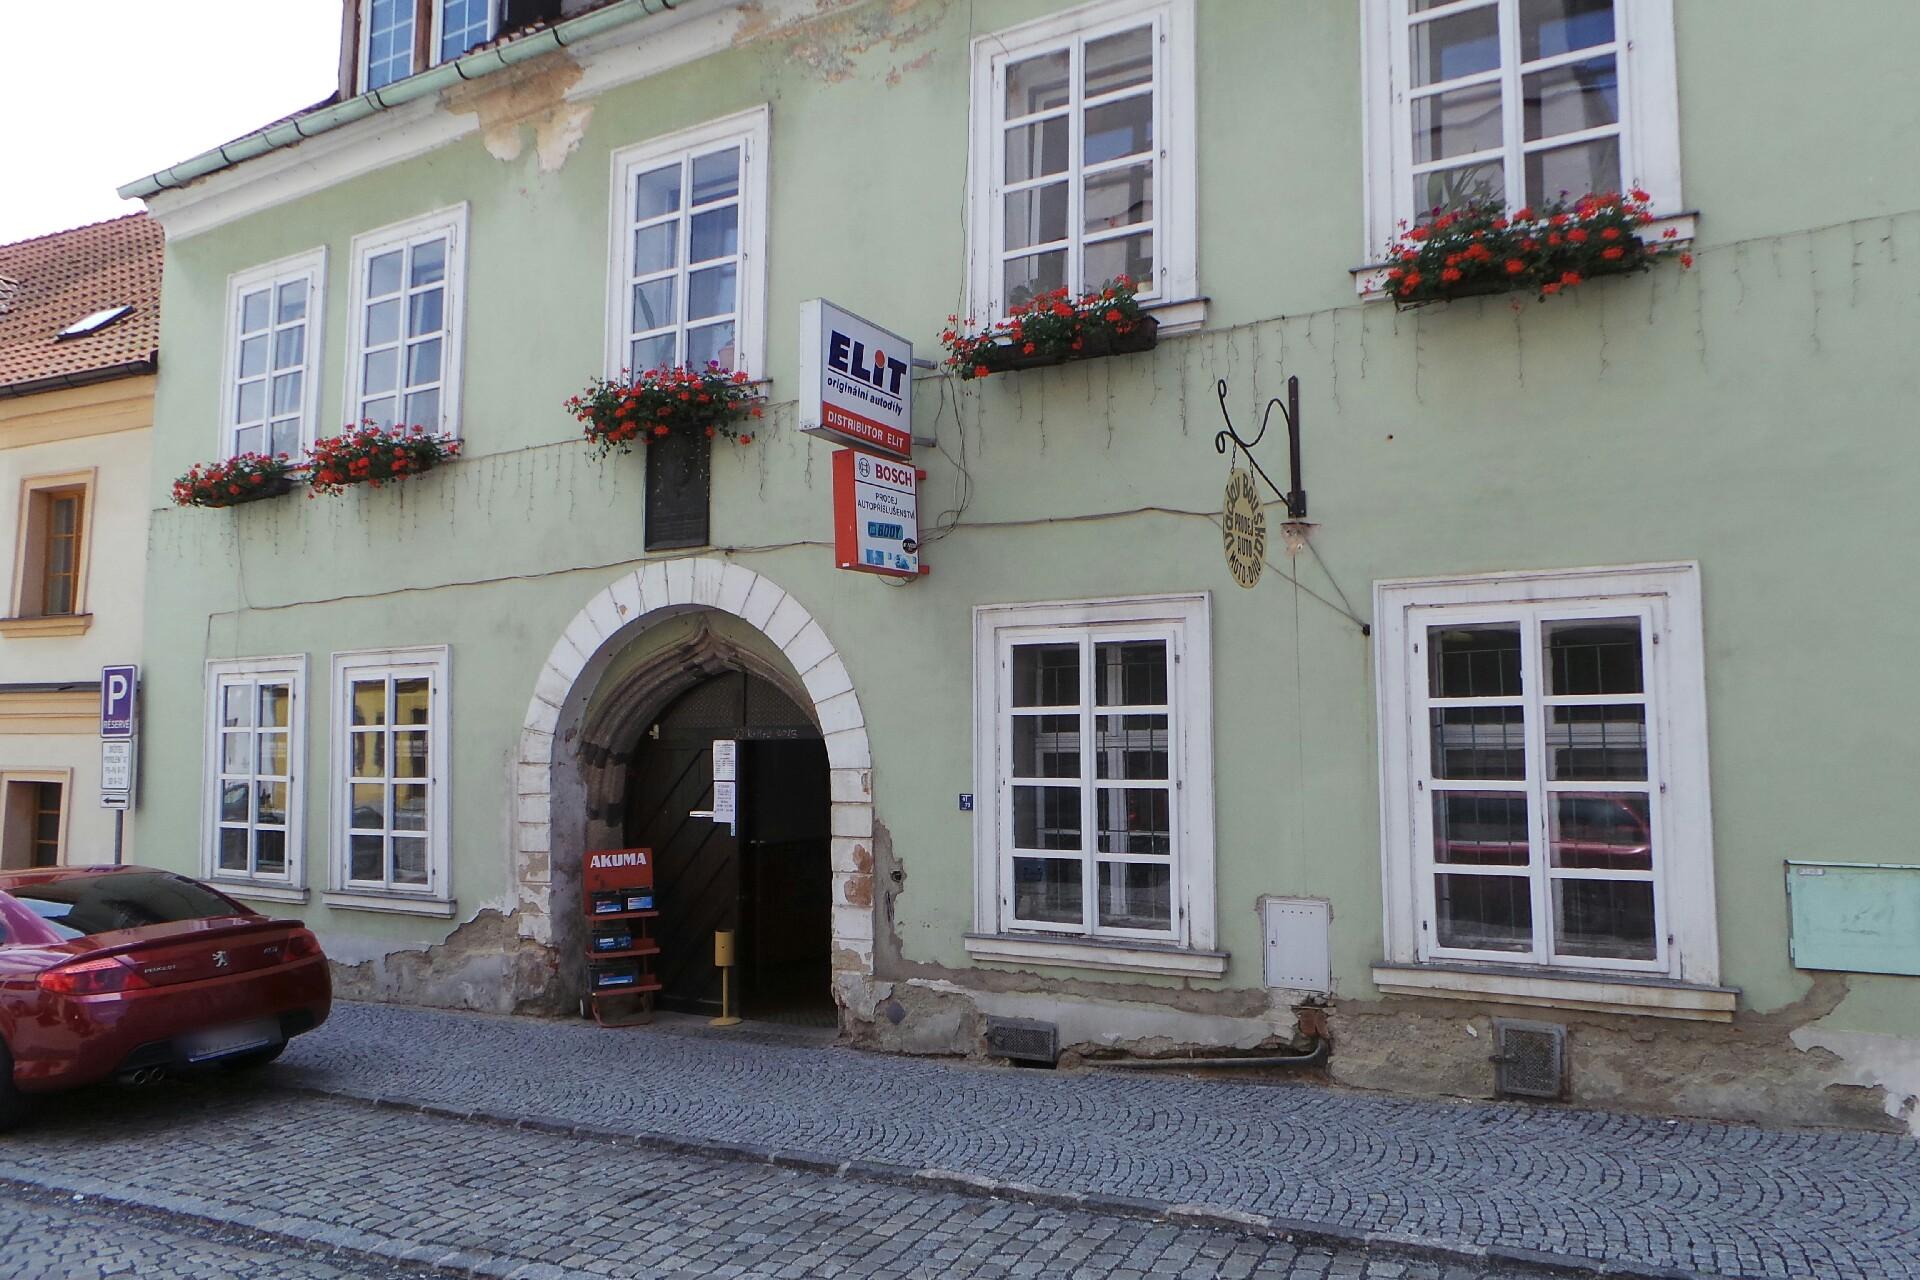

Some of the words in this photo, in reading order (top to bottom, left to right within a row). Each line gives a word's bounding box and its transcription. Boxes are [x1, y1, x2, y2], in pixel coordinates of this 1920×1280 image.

[827, 376, 869, 401] originální
[869, 394, 904, 417] autodíly
[827, 410, 883, 441] DISTRIBUTOR
[887, 432, 904, 448] ELIT
[875, 463, 912, 487] BOSCH
[1234, 512, 1253, 537] PRODEJ
[1237, 536, 1252, 558] AUTO
[108, 675, 128, 715] P
[590, 852, 646, 868] AKUMA
